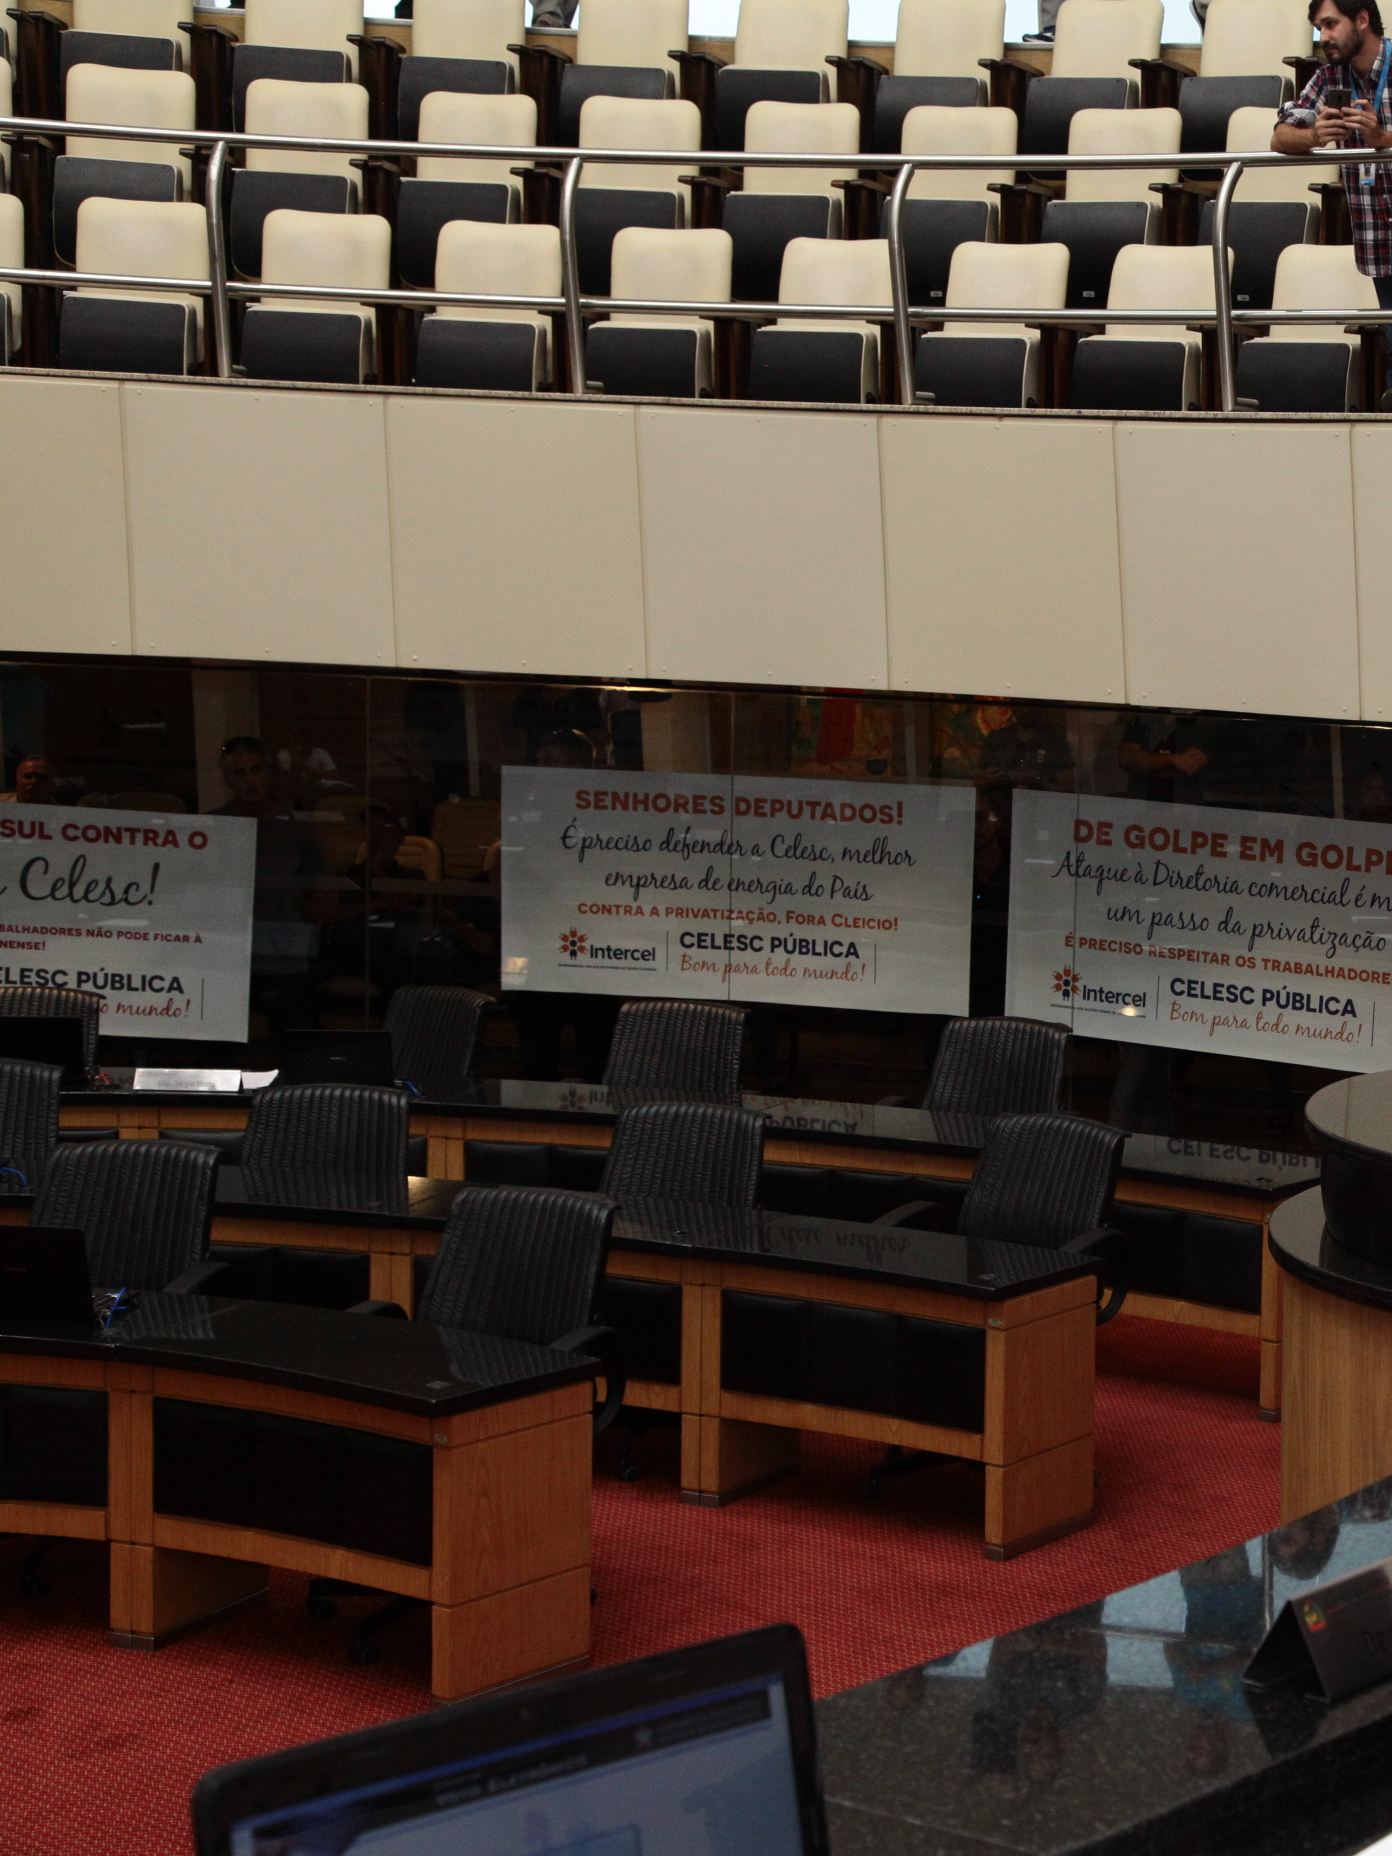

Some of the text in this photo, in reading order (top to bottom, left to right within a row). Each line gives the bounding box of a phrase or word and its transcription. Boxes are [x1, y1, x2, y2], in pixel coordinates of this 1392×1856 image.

[575, 789, 904, 825] SENHORES DEPUTADOS!
[0, 818, 209, 850] SUL CONTRA O
[560, 817, 917, 867] É preciso defender a Celesc, melhor
[1073, 818, 1114, 847] DE
[1123, 824, 1229, 858] GOLPE
[1239, 835, 1285, 864] EM
[19, 854, 161, 907] Celesc!
[605, 865, 873, 905] empresa de energia do País
[1051, 850, 1131, 897] Ataque
[1134, 862, 1149, 885] à
[1152, 858, 1245, 895] Diretoria
[1248, 877, 1351, 908] comercial
[1354, 885, 1367, 908] é
[577, 902, 645, 917] CONTRA
[649, 906, 661, 918] A
[665, 906, 782, 926] PRIVATIZAÇÃO,
[86, 926, 113, 940] NÃO
[116, 930, 150, 941] PODE
[153, 933, 190, 944] FICAR
[194, 934, 203, 945] À
[679, 931, 860, 959] CELESC PÚBLICA
[1064, 931, 1076, 948] É
[1079, 936, 1144, 956] PRECISO
[1148, 945, 1231, 967] RESPEITAR
[1235, 955, 1257, 969] OS
[1107, 906, 1387, 959] um passo da privatização
[590, 943, 656, 961] Intercel
[680, 952, 719, 972] Bom
[721, 961, 762, 983] para
[764, 956, 798, 978] todo
[802, 961, 866, 982] mundo!
[76, 967, 185, 994] PÚBLICA
[1082, 984, 1147, 1008] Intercel
[1170, 977, 1358, 1018] CELESC PÚBLICA
[115, 997, 191, 1018] mundo!
[1169, 1000, 1208, 1025] Bom
[1209, 1010, 1252, 1037] para
[1255, 1011, 1290, 1035] todo
[1295, 1020, 1363, 1044] mundo!
